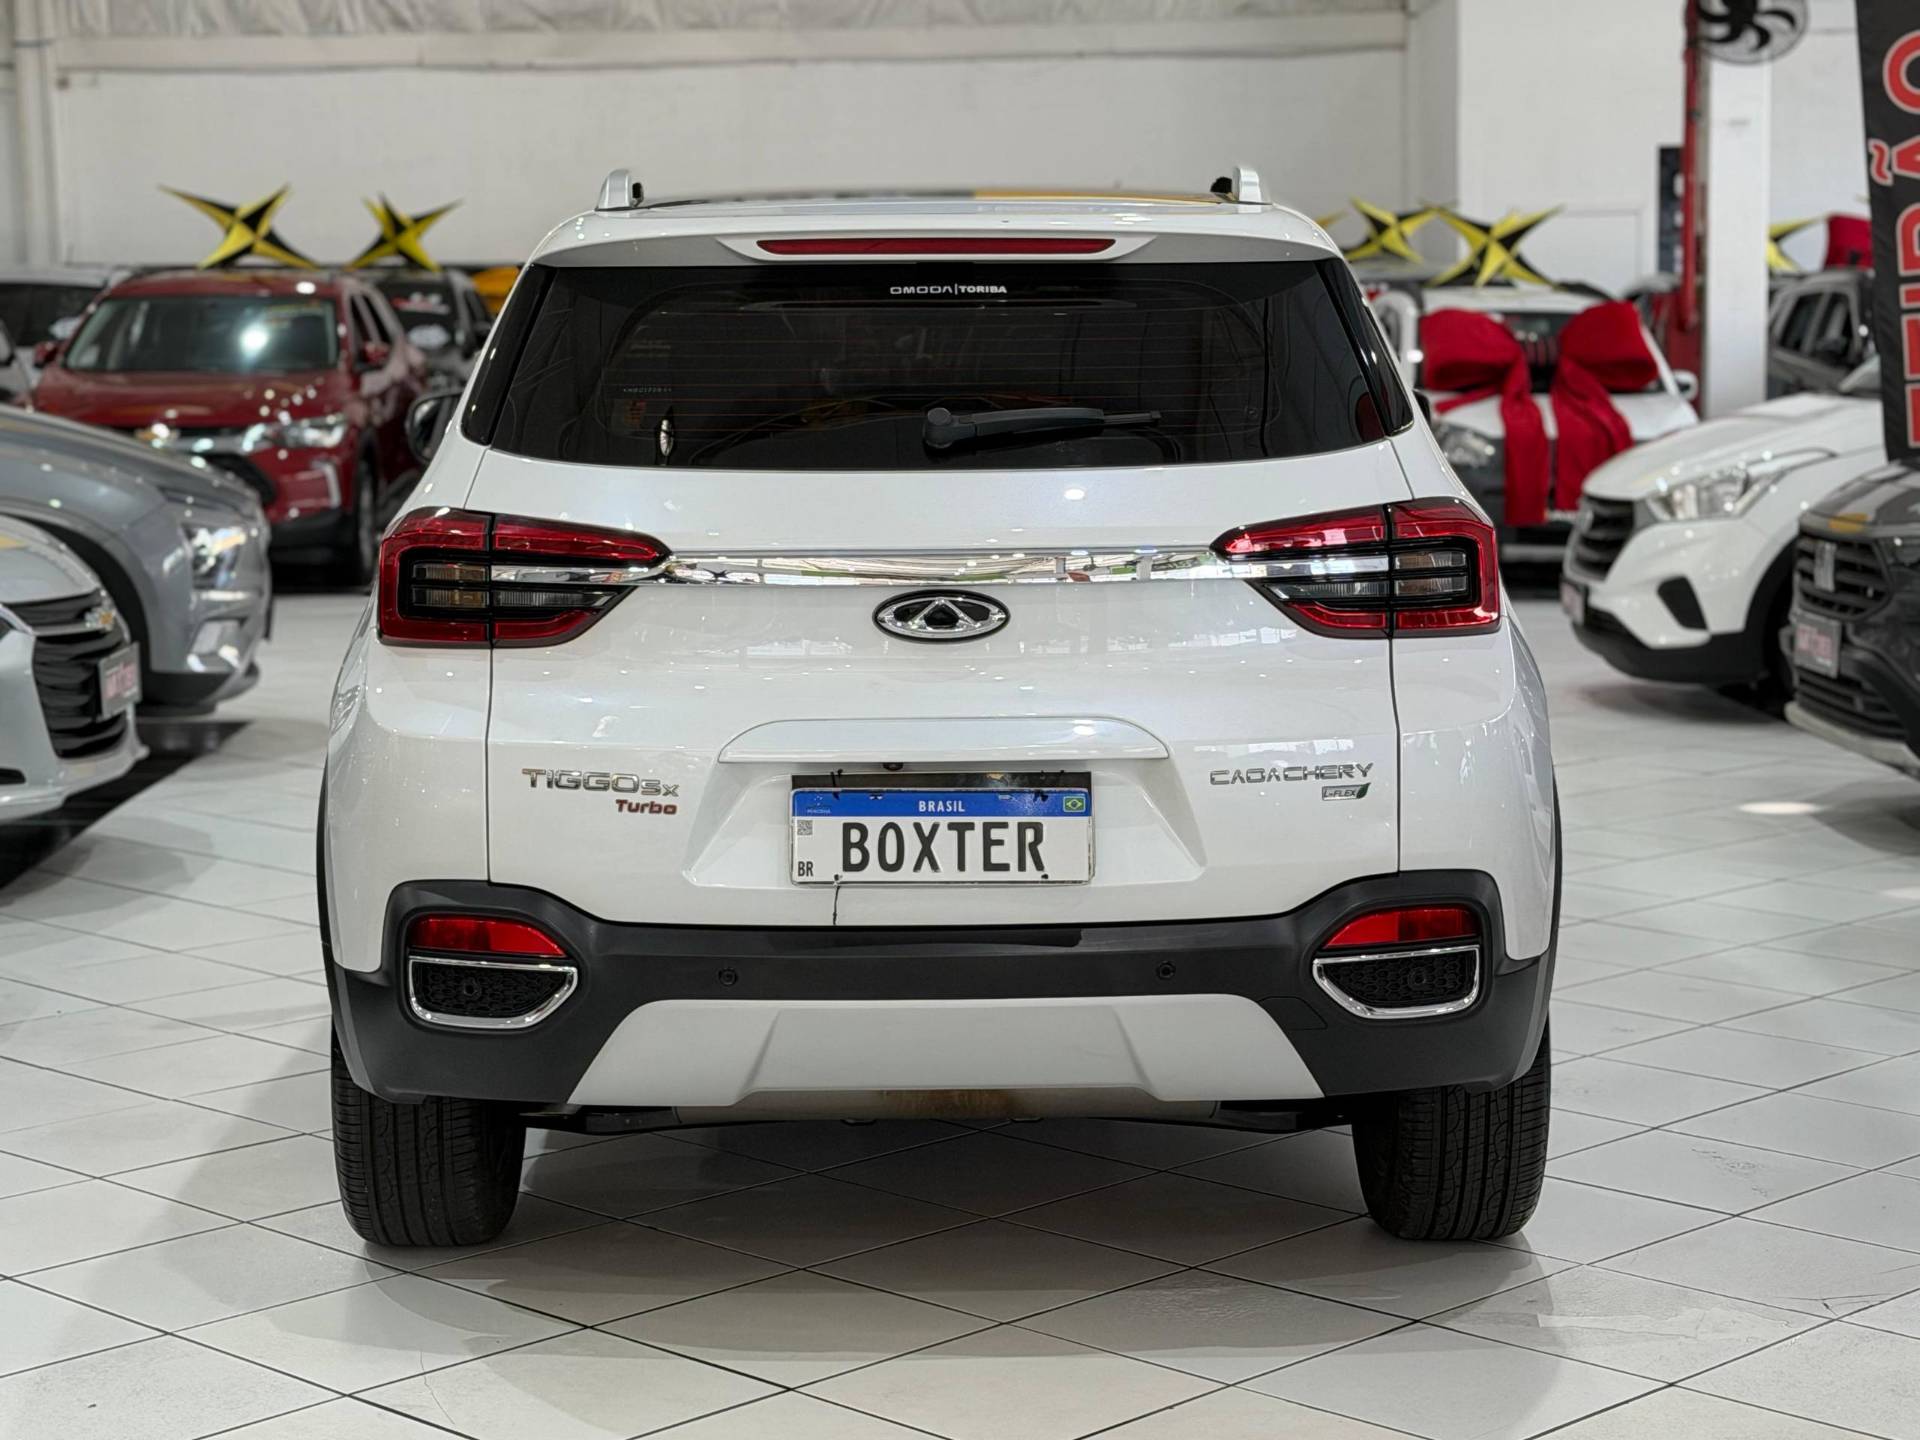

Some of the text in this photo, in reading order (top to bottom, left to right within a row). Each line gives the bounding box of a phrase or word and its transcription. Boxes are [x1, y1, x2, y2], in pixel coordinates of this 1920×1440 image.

[616, 799, 677, 815] Turbo
[918, 800, 965, 812] BRASIL
[842, 821, 1046, 872] BOXTER
[797, 861, 814, 877] BR
